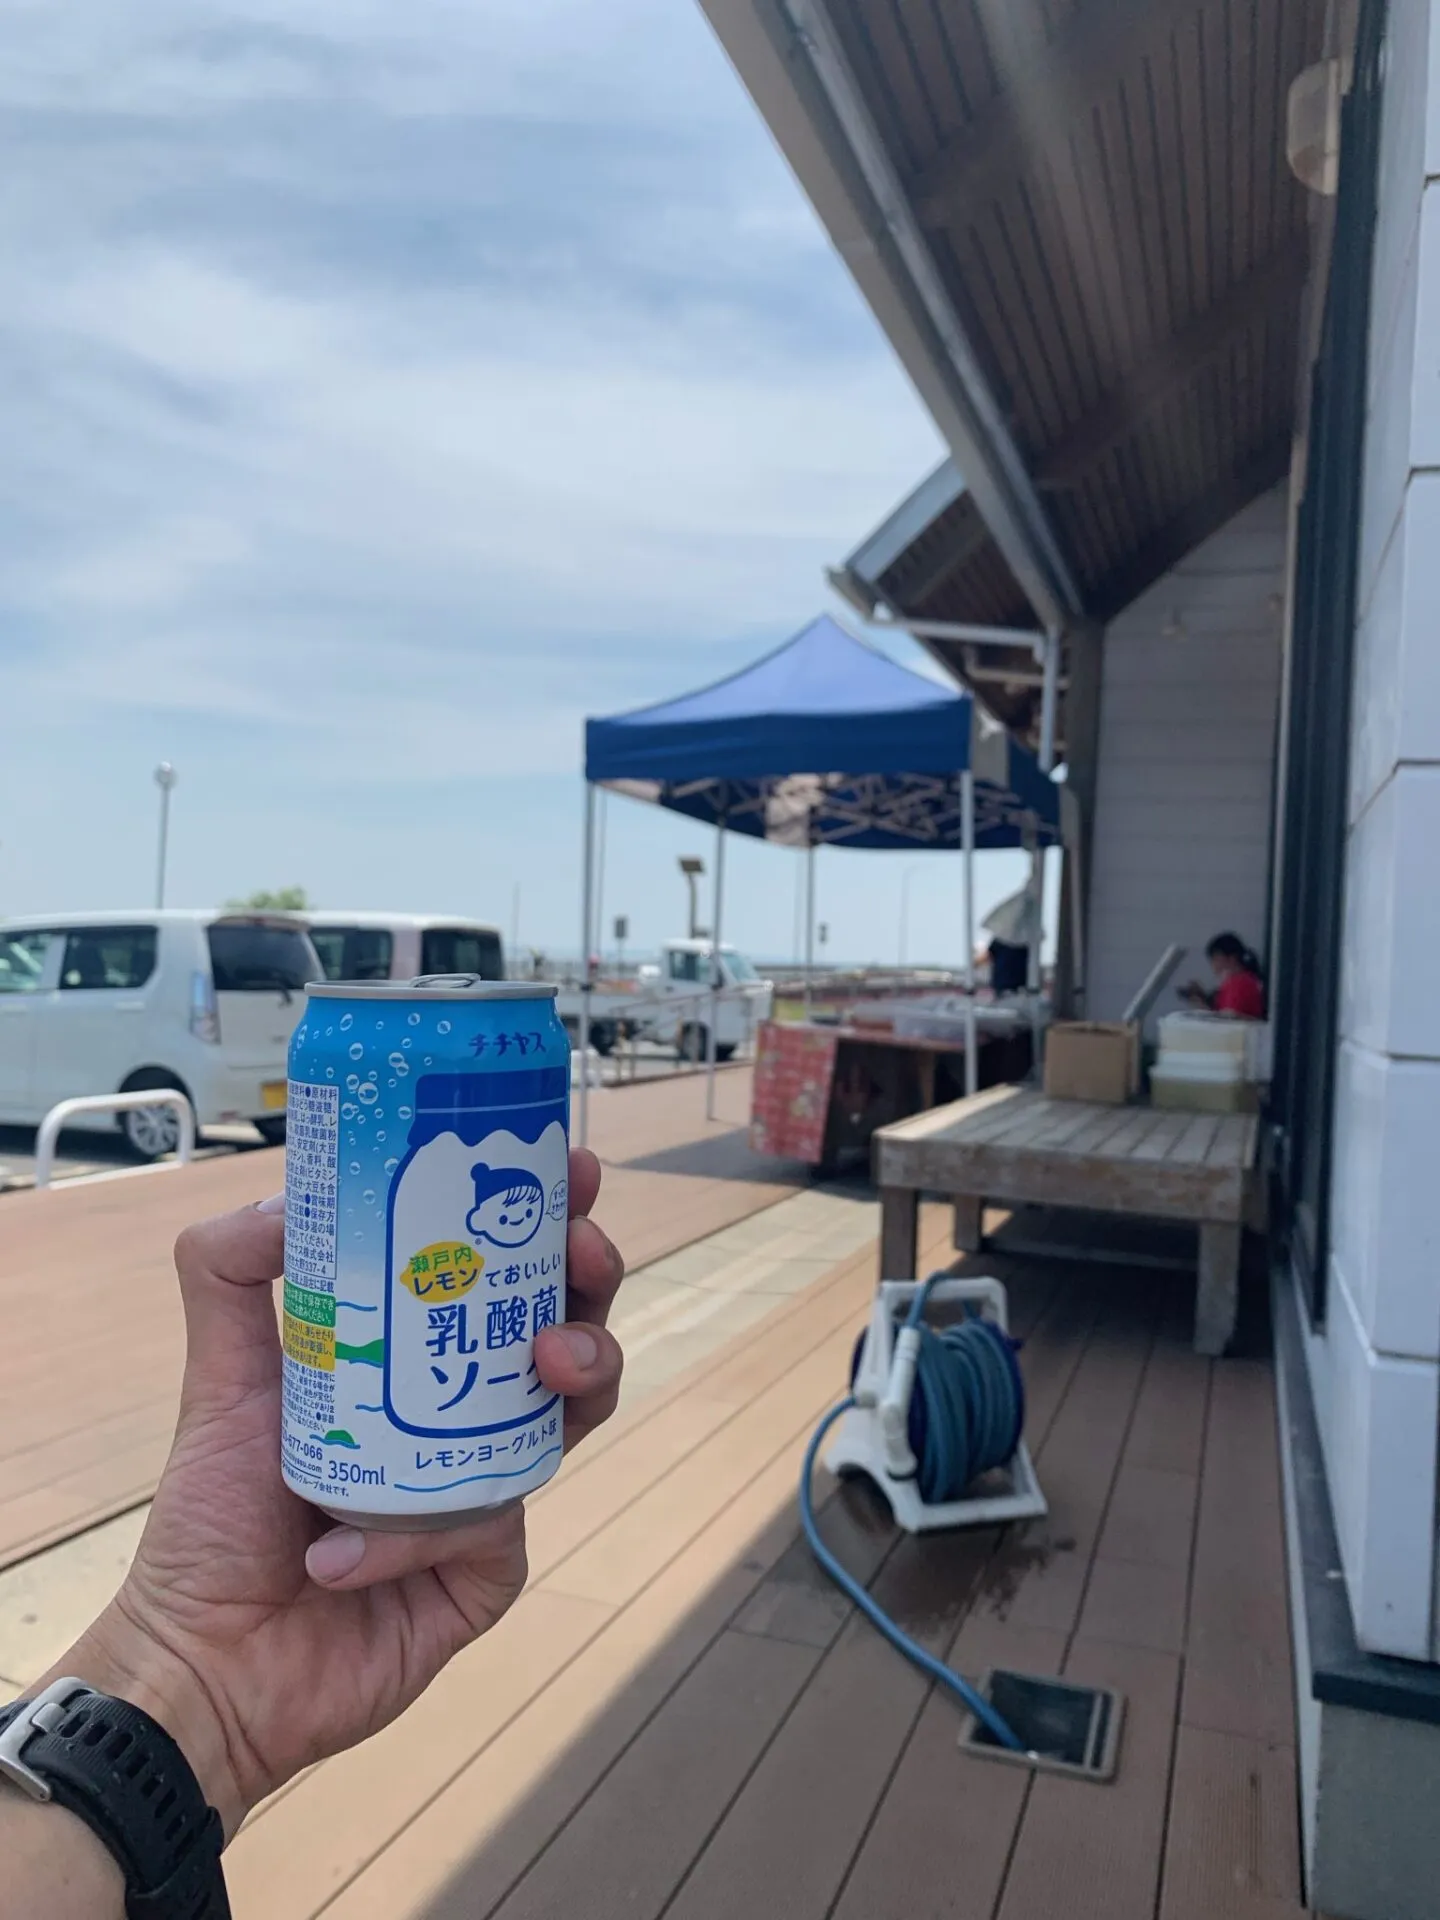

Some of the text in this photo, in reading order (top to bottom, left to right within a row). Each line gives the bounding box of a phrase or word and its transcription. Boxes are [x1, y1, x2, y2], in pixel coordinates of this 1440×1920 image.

[468, 1031, 547, 1057] チチヤス
[409, 1245, 472, 1275] 瀬戸内
[413, 1268, 478, 1296] レモン
[425, 1284, 558, 1357] 乳酸菌
[416, 1416, 557, 1470] レモンヨーグルト味
[327, 1460, 387, 1487] 350ml
